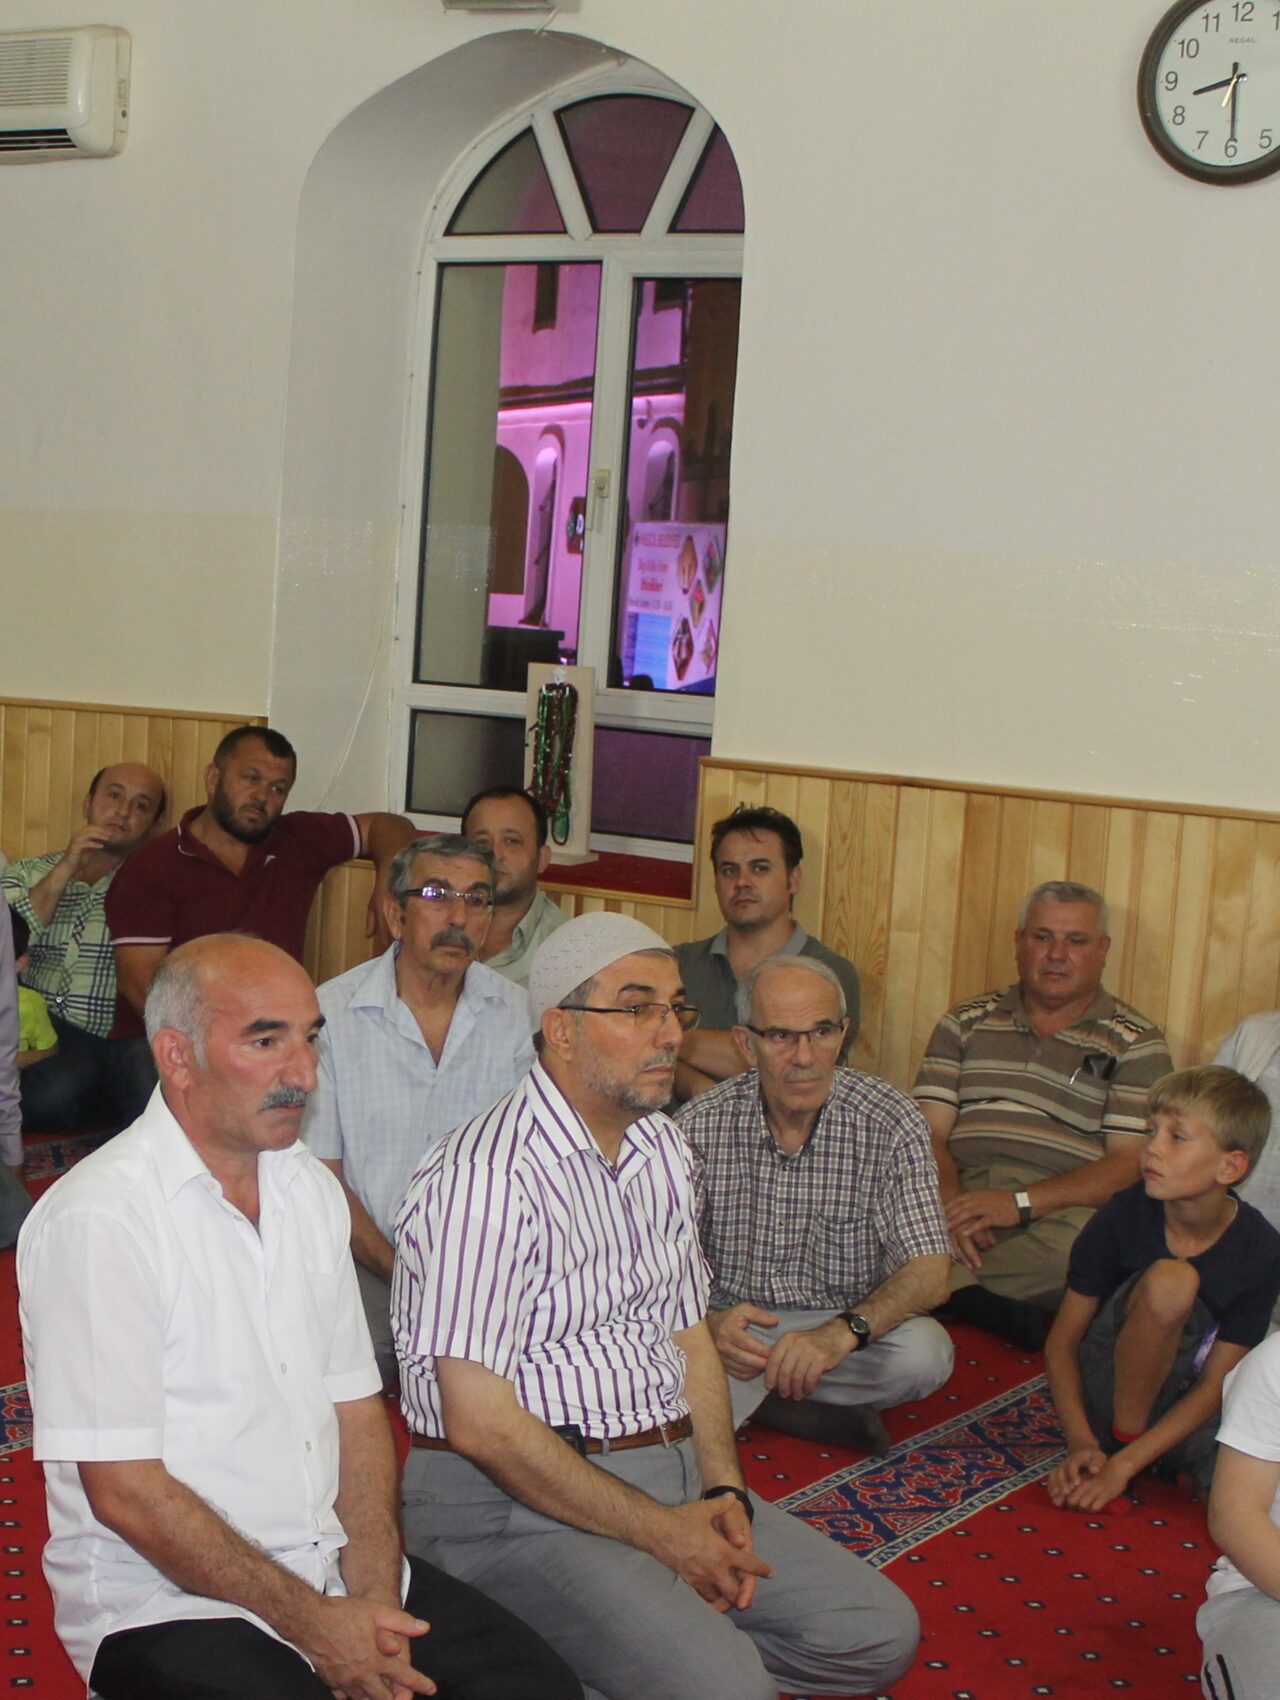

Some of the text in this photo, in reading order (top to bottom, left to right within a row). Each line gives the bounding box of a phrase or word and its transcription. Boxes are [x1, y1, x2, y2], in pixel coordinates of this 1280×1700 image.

[1232, 1, 1255, 22] 12
[1202, 13, 1220, 33] 11
[1177, 38, 1200, 59] 10
[1164, 71, 1178, 91] 9
[1172, 105, 1185, 126] 8
[1196, 130, 1209, 150] 7
[1224, 138, 1238, 158] 6
[1258, 129, 1273, 149] 5
